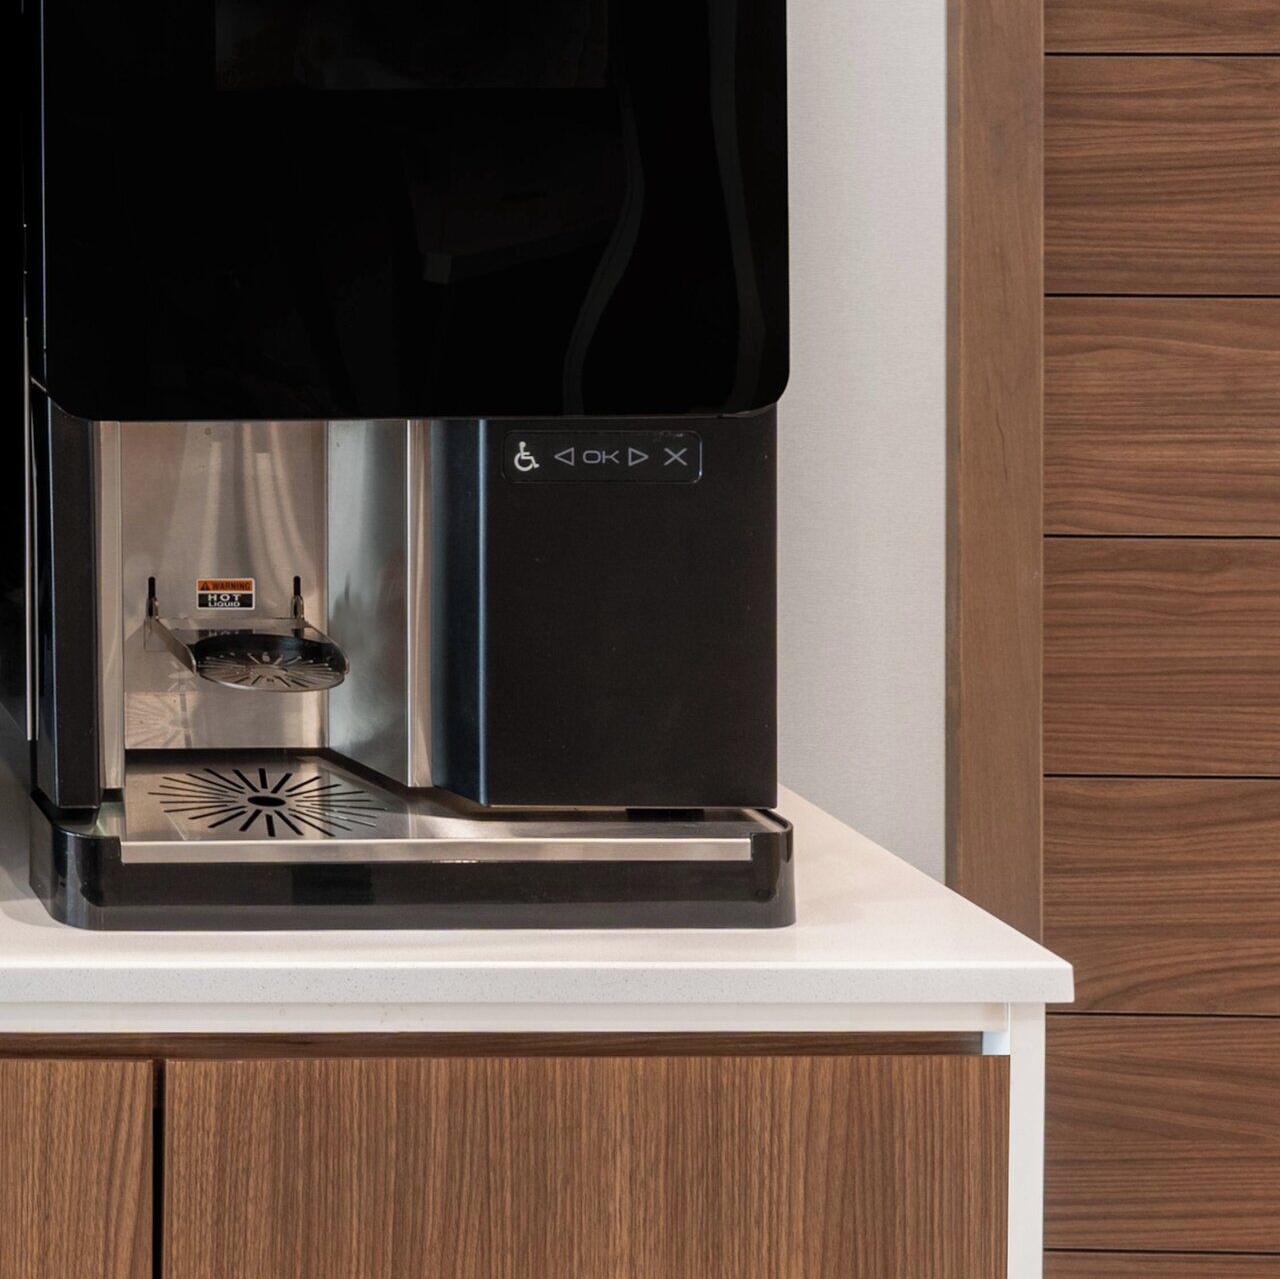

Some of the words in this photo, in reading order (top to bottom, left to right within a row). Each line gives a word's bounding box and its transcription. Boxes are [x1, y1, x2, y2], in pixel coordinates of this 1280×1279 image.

[582, 450, 620, 464] OK
[212, 581, 250, 591] WARNING
[208, 594, 241, 602] HOT
